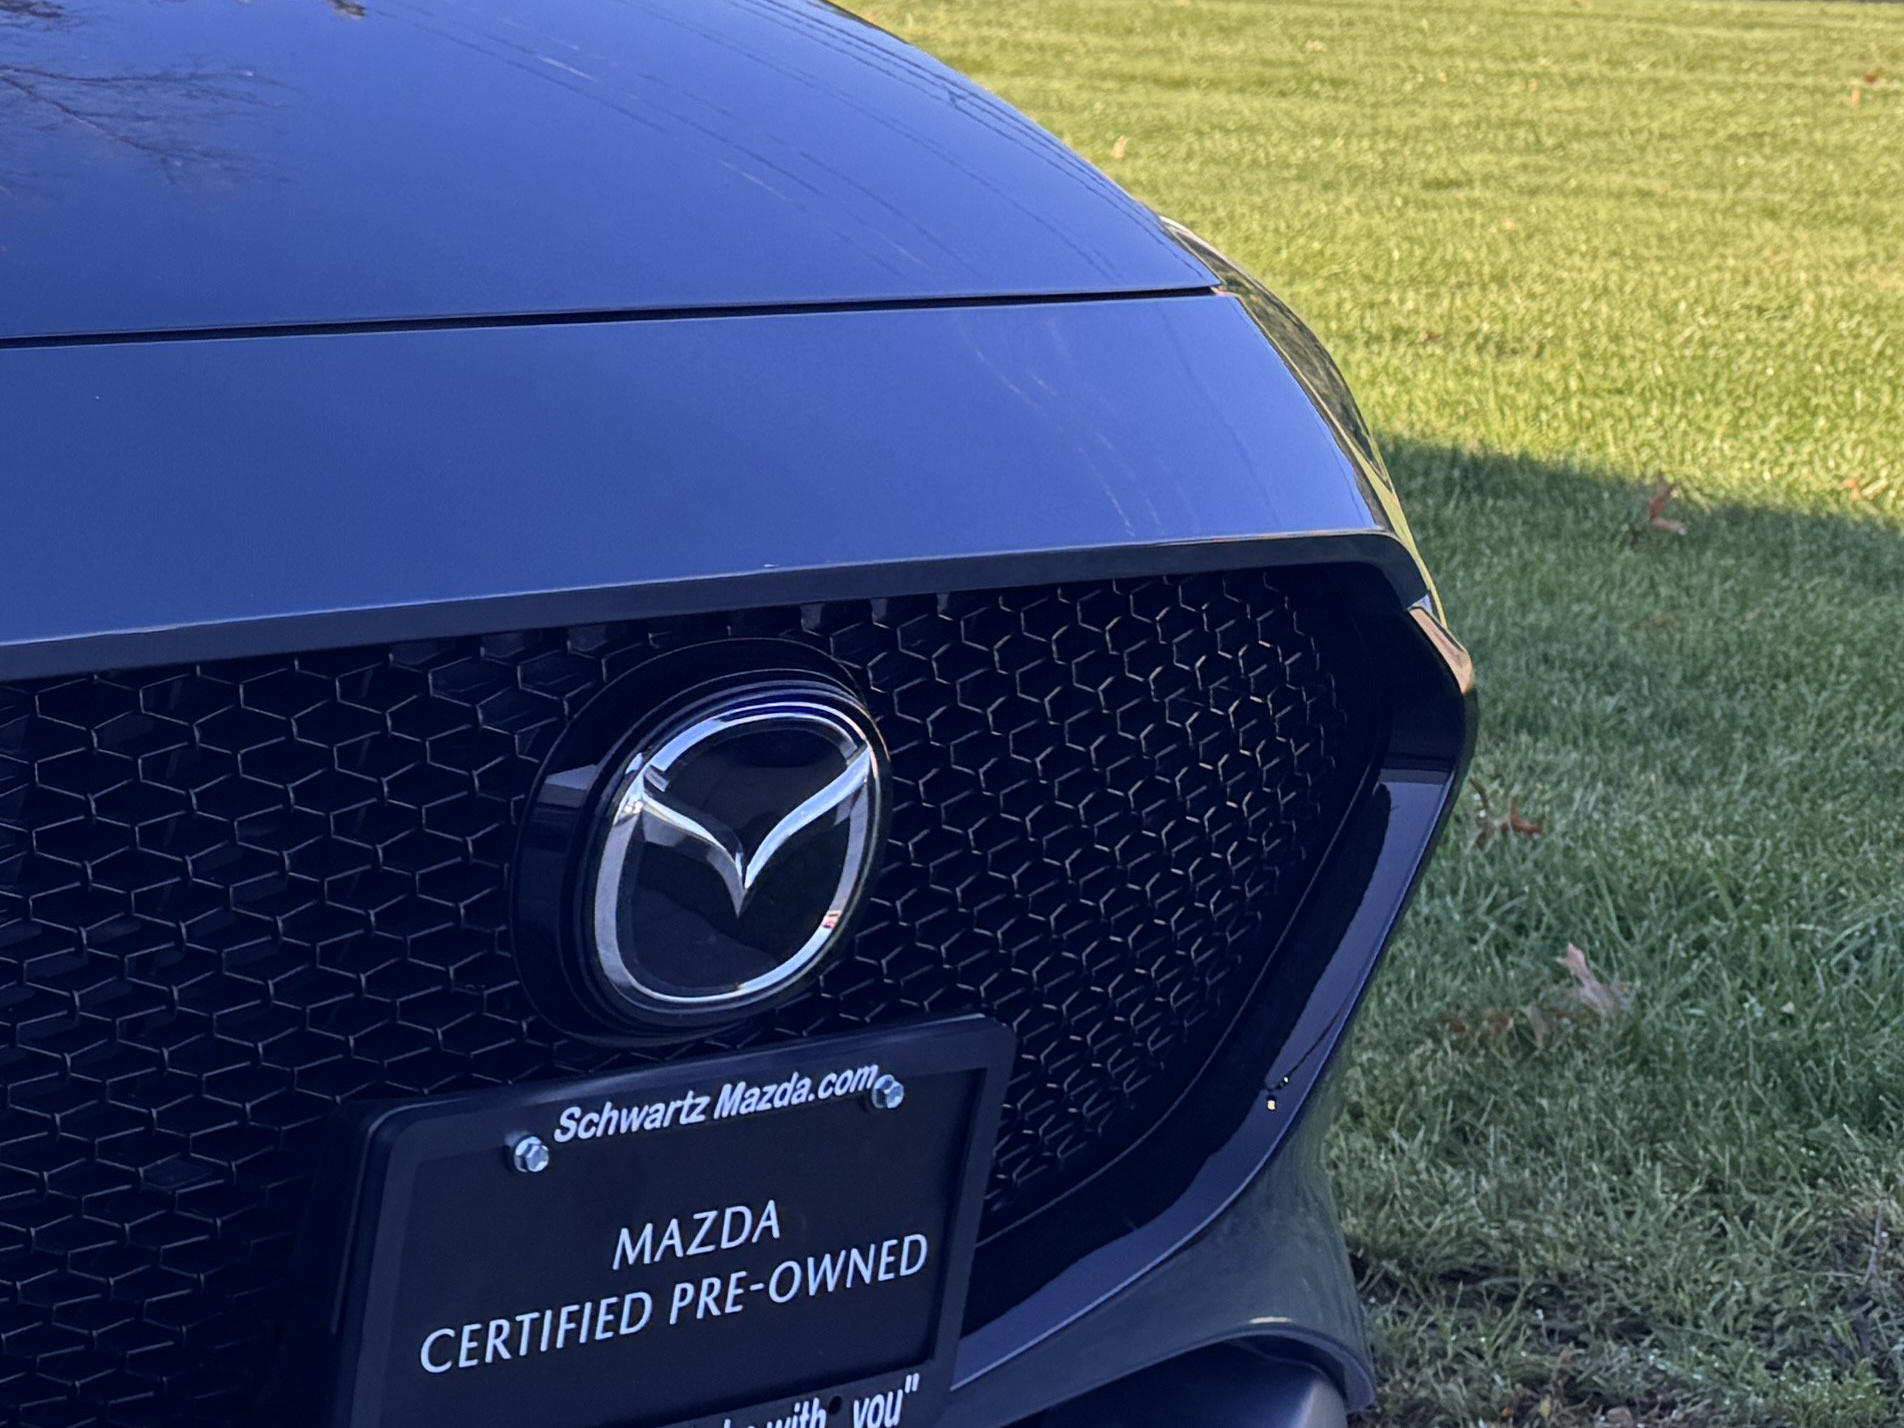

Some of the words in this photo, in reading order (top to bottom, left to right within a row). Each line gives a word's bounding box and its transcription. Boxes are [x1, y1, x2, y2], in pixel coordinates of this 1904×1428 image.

[553, 1089, 711, 1143] Schwartz
[713, 1063, 879, 1120] Mazda.com
[612, 1199, 780, 1270] MAZDA
[420, 1291, 653, 1373] CERTIFIED
[669, 1233, 928, 1325] PRE-OWNED
